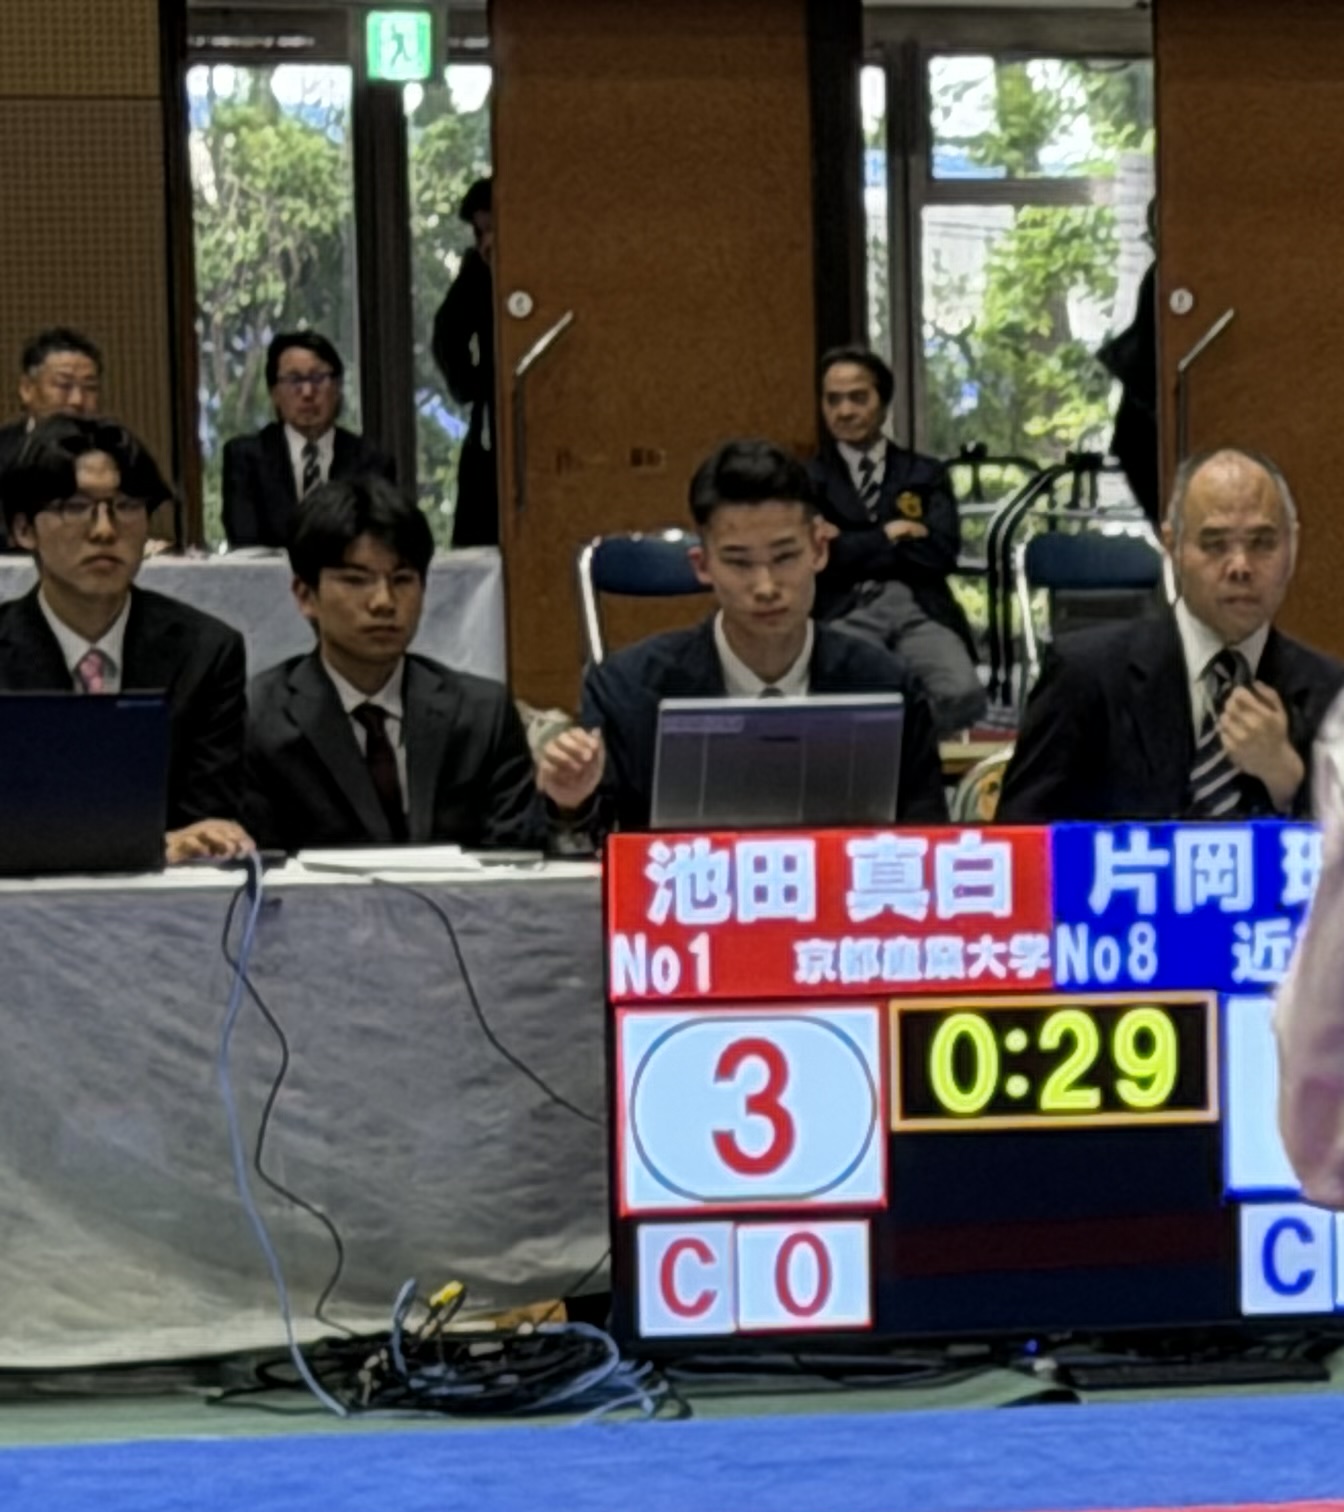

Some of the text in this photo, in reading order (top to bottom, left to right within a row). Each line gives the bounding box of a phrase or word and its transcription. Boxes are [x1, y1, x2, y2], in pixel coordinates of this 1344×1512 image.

[644, 830, 1013, 925] 池田 真白
[1088, 828, 1254, 915] 片岡
[612, 932, 711, 996] No1
[1056, 921, 1158, 985] No8
[929, 1006, 1179, 1114] 0:29
[712, 1036, 796, 1176] 3
[659, 1231, 833, 1318] C 0
[1261, 1216, 1315, 1297] C
